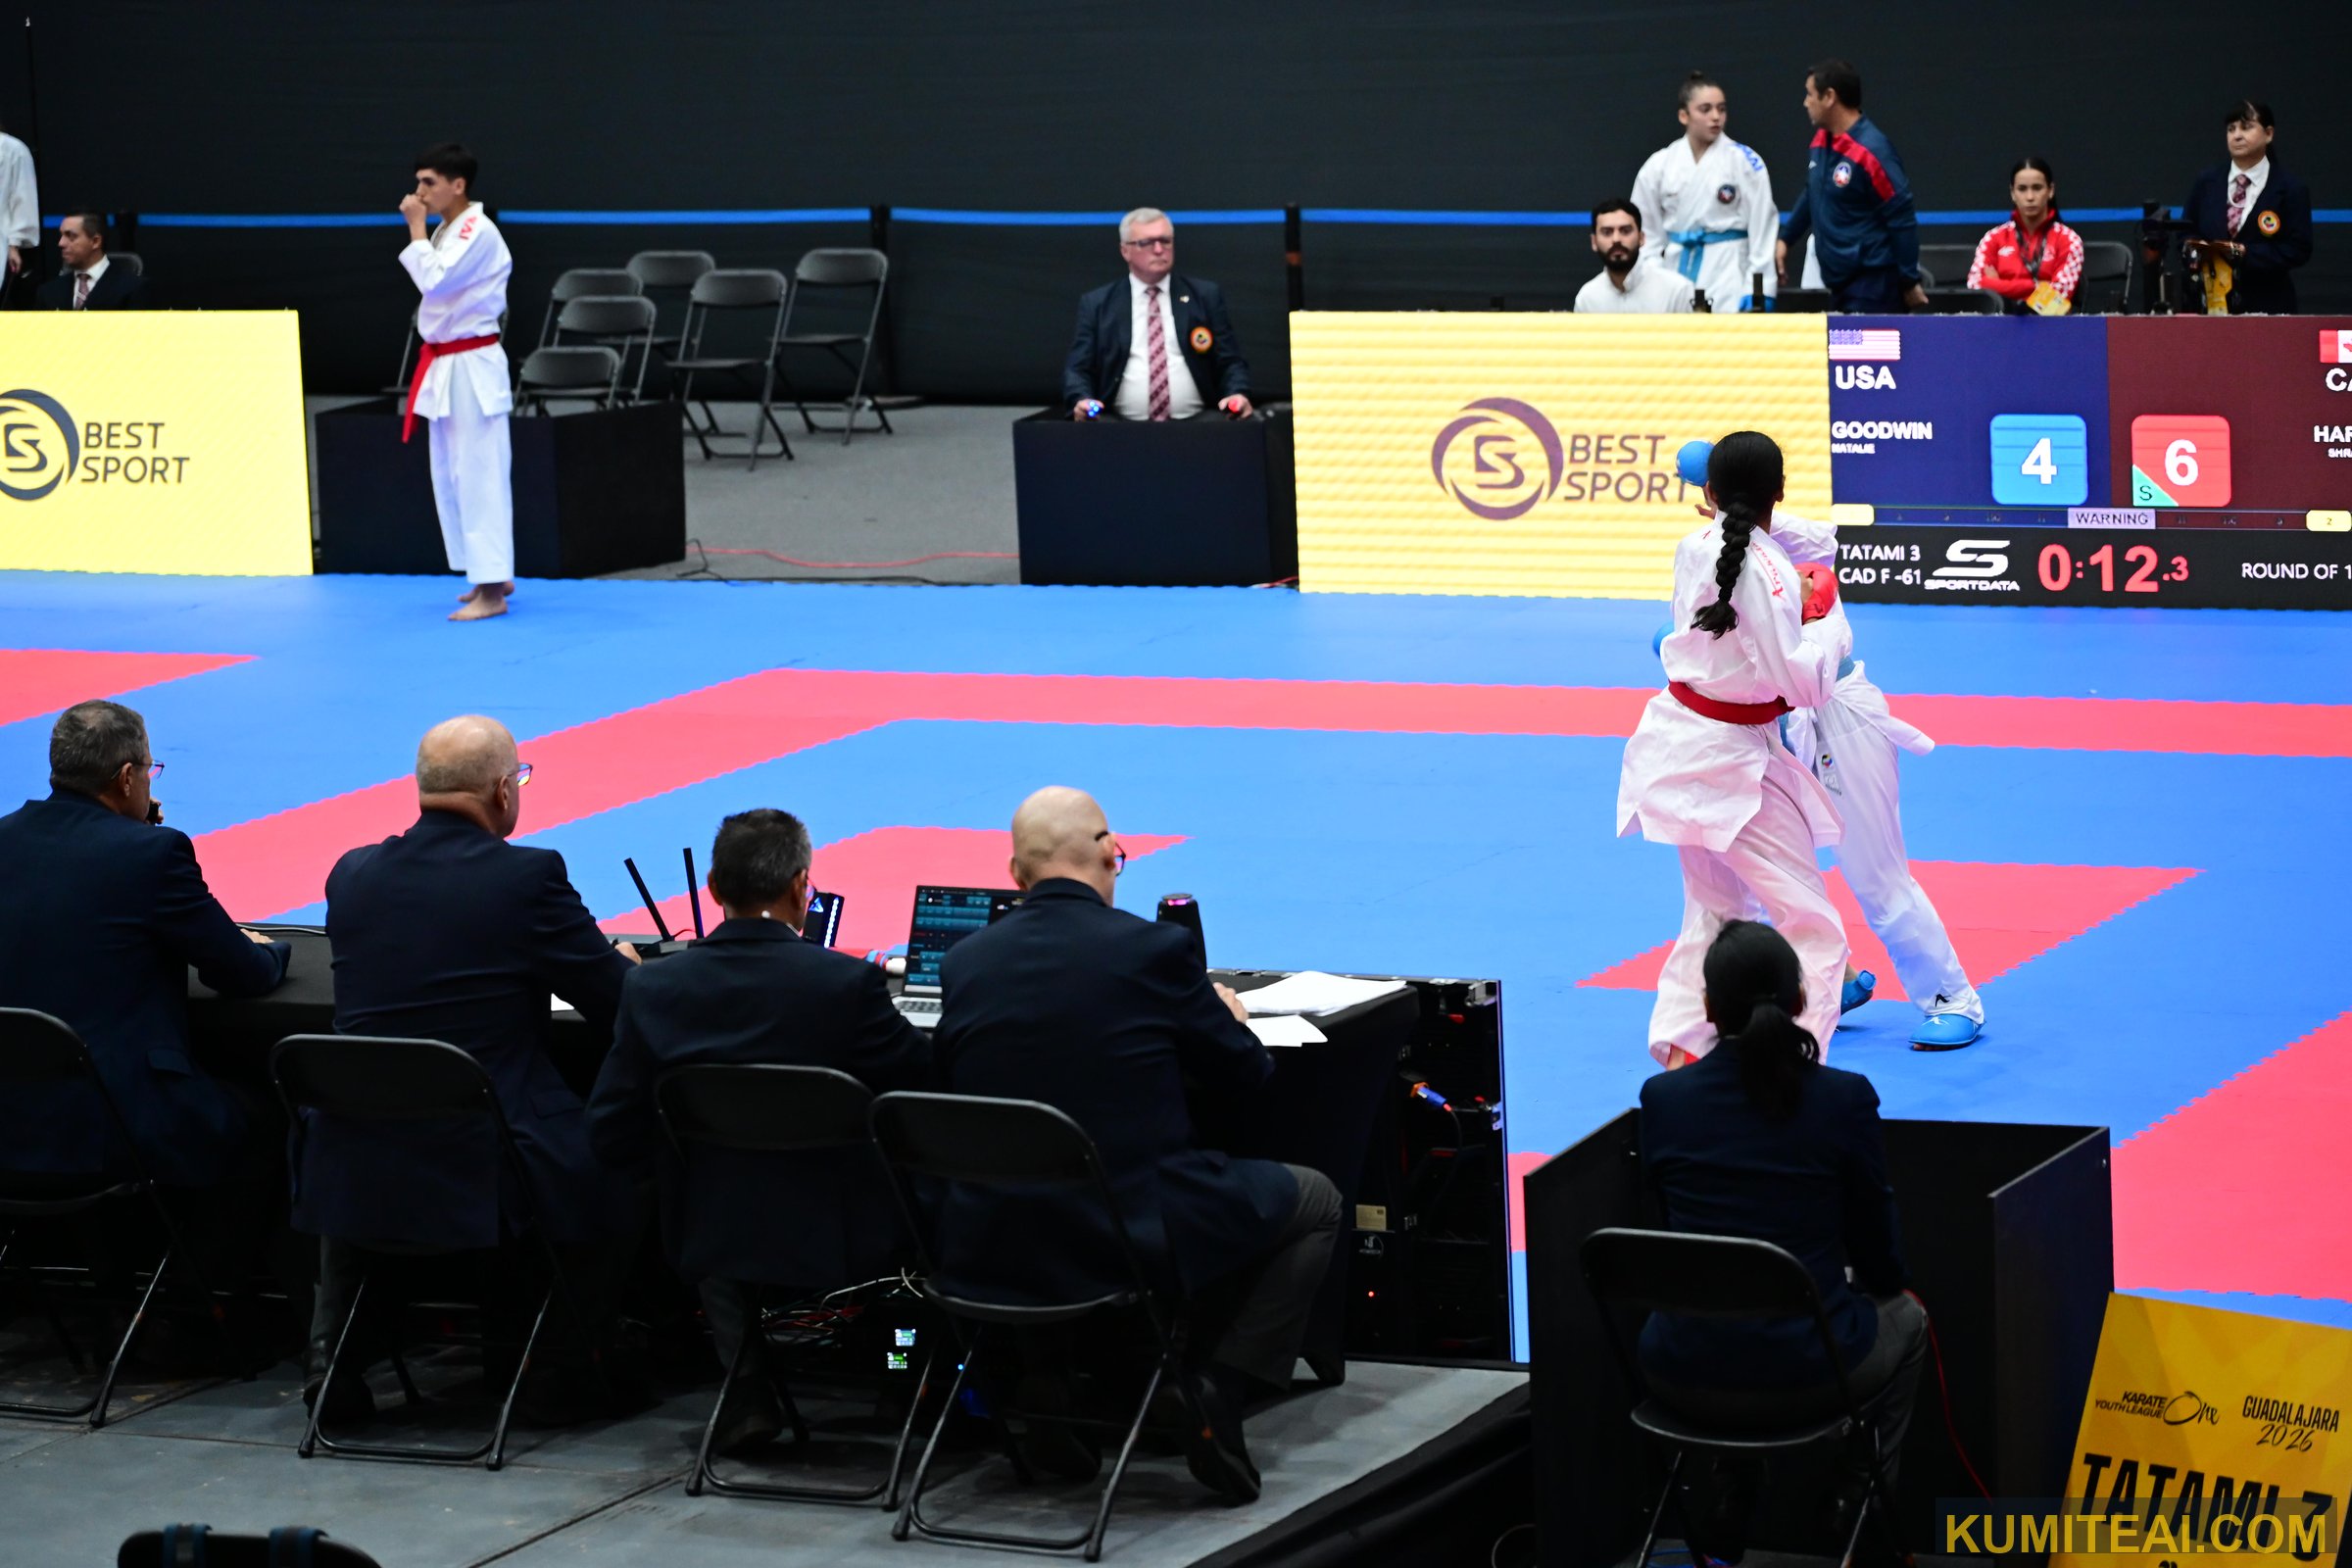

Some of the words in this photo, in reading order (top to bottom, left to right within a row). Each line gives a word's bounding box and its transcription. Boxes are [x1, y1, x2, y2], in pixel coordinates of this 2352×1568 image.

[1835, 365, 1897, 390] USA
[2326, 368, 2352, 392] C
[84, 421, 165, 449] BEST
[1831, 420, 1934, 440] GOODWIN
[1569, 434, 1666, 465] BEST
[2021, 437, 2057, 485] 4
[2164, 439, 2199, 486] 6
[81, 456, 190, 484] SPORT
[1564, 471, 1687, 503] SPORT
[2139, 485, 2153, 501] S
[2076, 513, 2149, 525] WARNING
[1839, 544, 1905, 561] TATAMI
[1910, 544, 1921, 562] 3
[1838, 567, 1877, 584] CAD
[1881, 568, 1890, 584] F
[1894, 568, 1921, 585] -61
[2241, 563, 2309, 579] ROUND
[2314, 564, 2338, 579] OF
[1924, 579, 2020, 591] SPORTDATA
[2095, 1399, 2126, 1412] YOUTH
[2126, 1402, 2164, 1419] LEAGUE
[2122, 1392, 2168, 1409] KARATE
[2163, 1391, 2220, 1426] One
[2242, 1396, 2340, 1433] GUADALAJARA
[2256, 1423, 2315, 1452] 2026
[2079, 1452, 2280, 1550] TATAMI
